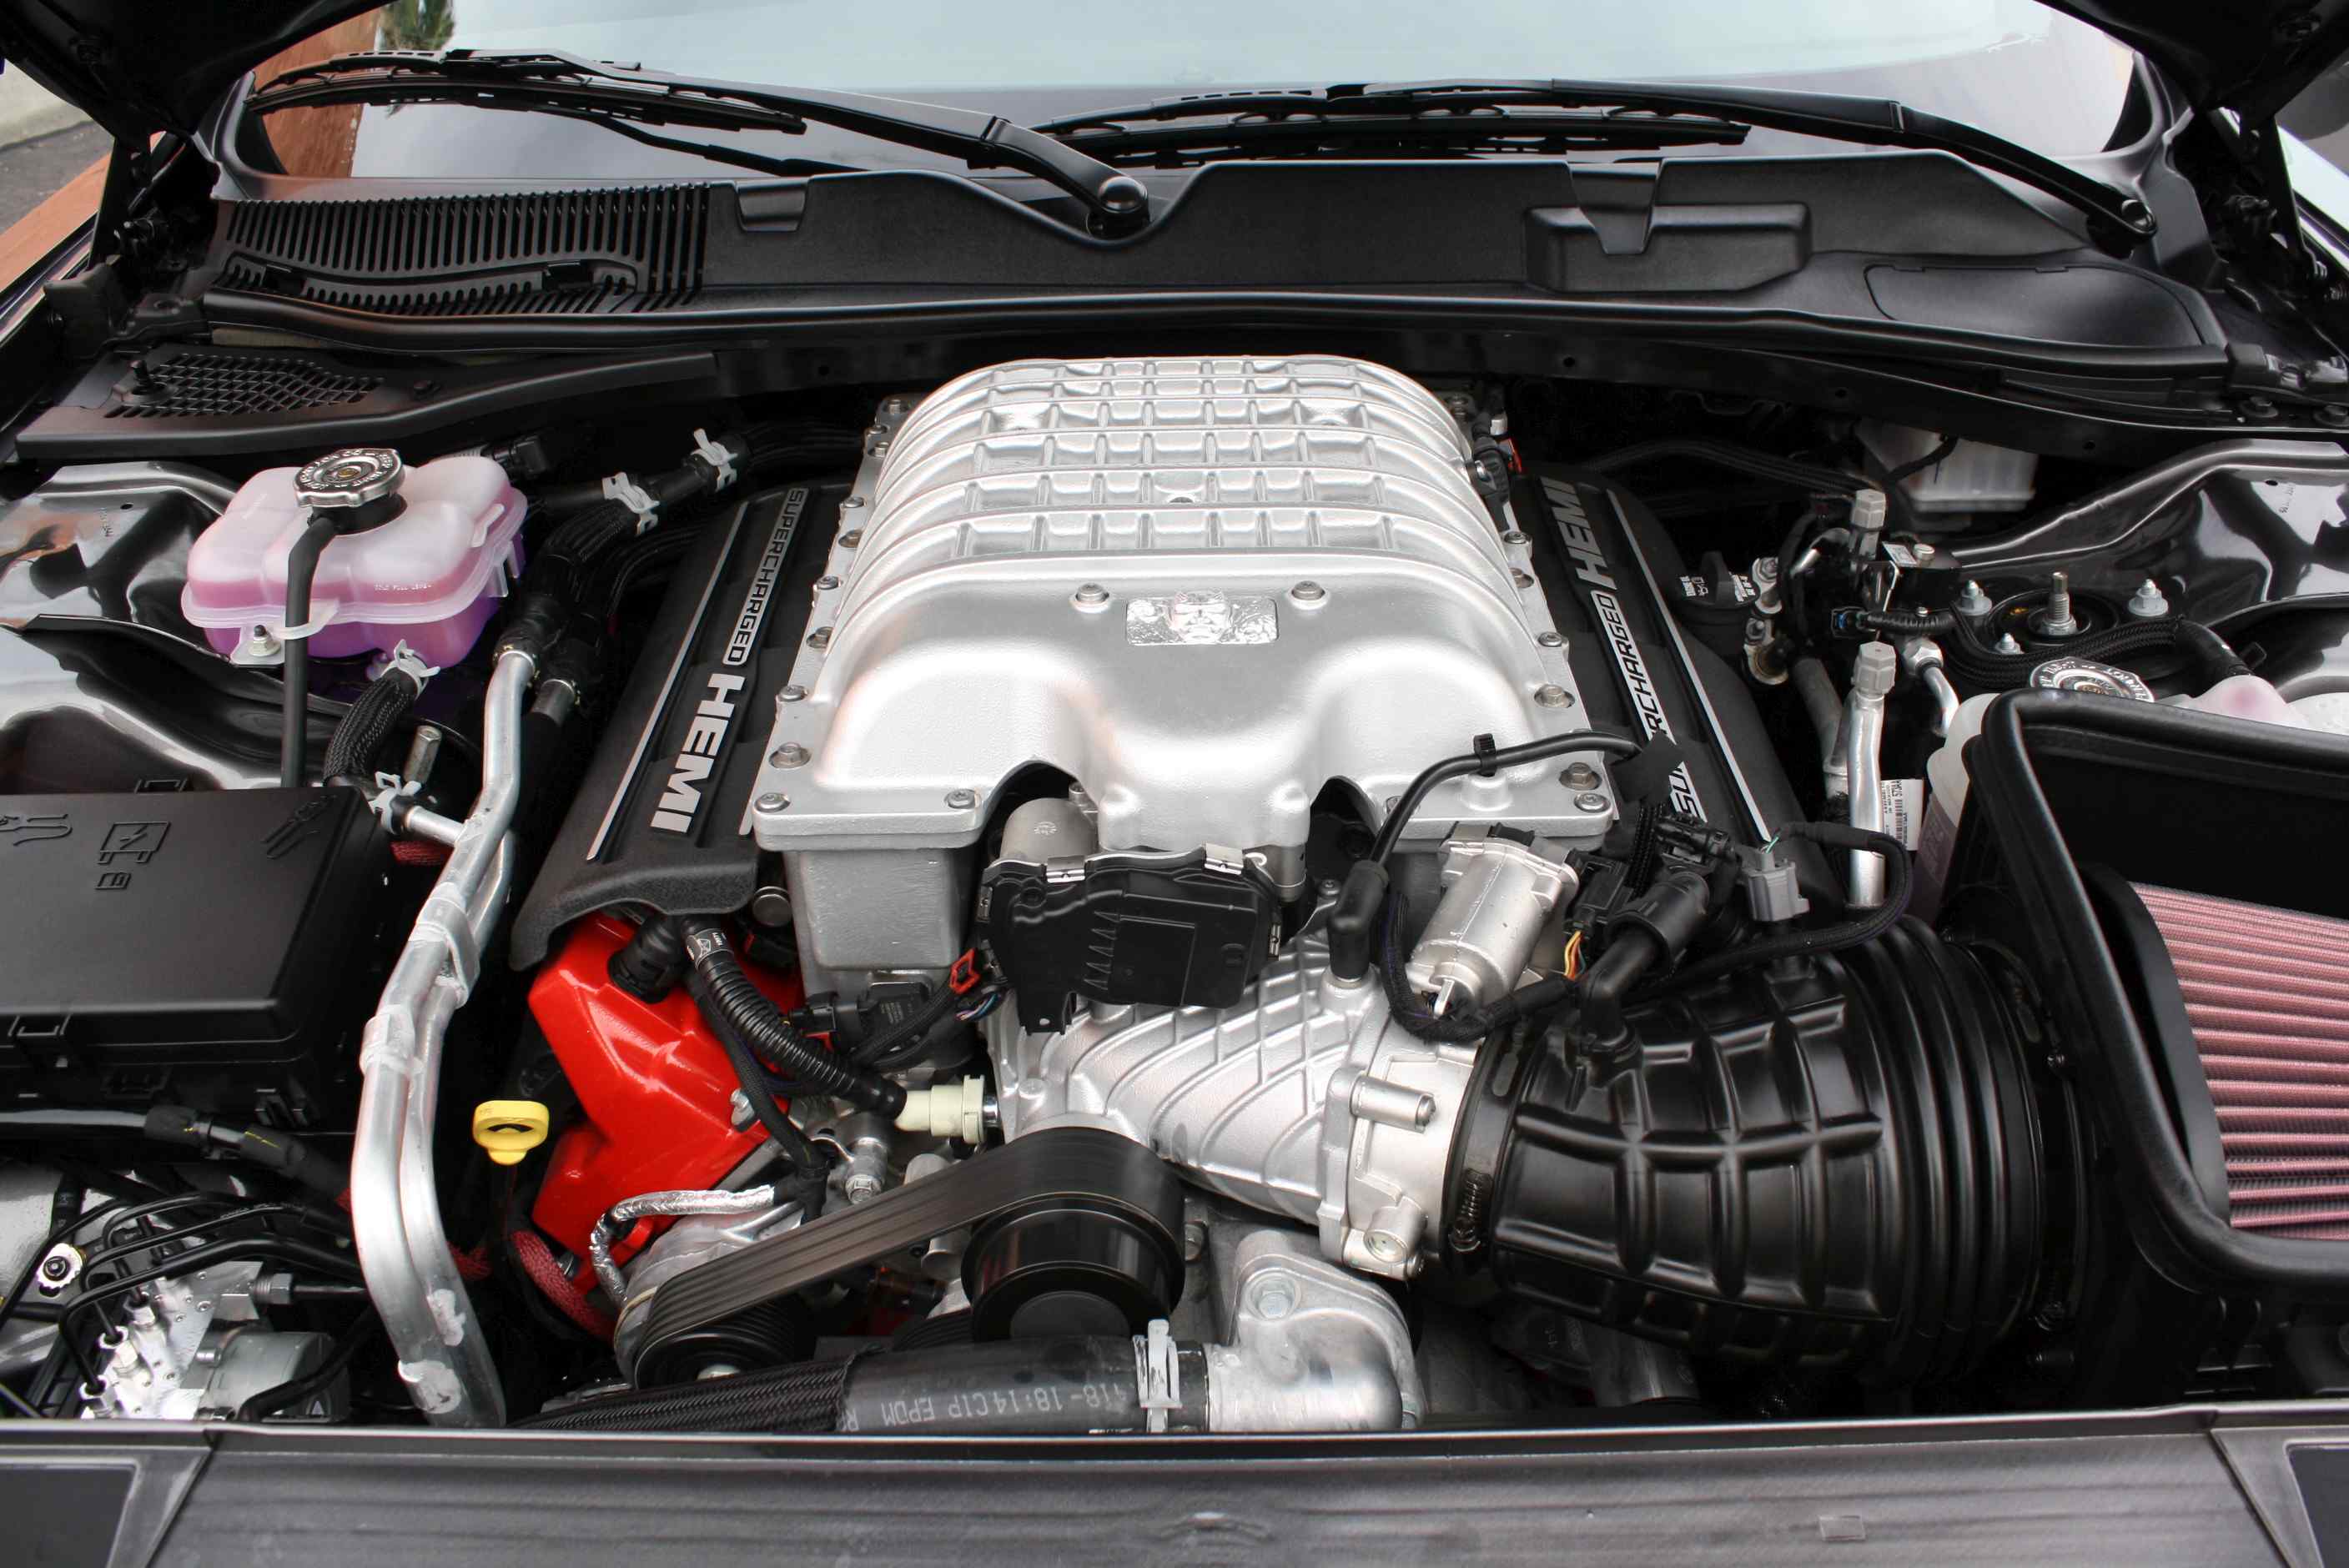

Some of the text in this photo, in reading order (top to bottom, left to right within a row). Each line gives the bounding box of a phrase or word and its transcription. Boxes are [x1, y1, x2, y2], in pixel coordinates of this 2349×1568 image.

[650, 489, 807, 833] SUPERCHARGED HEMI
[1540, 476, 1703, 817] SURCHARGED HEMI
[880, 1395, 935, 1427] EPDM
